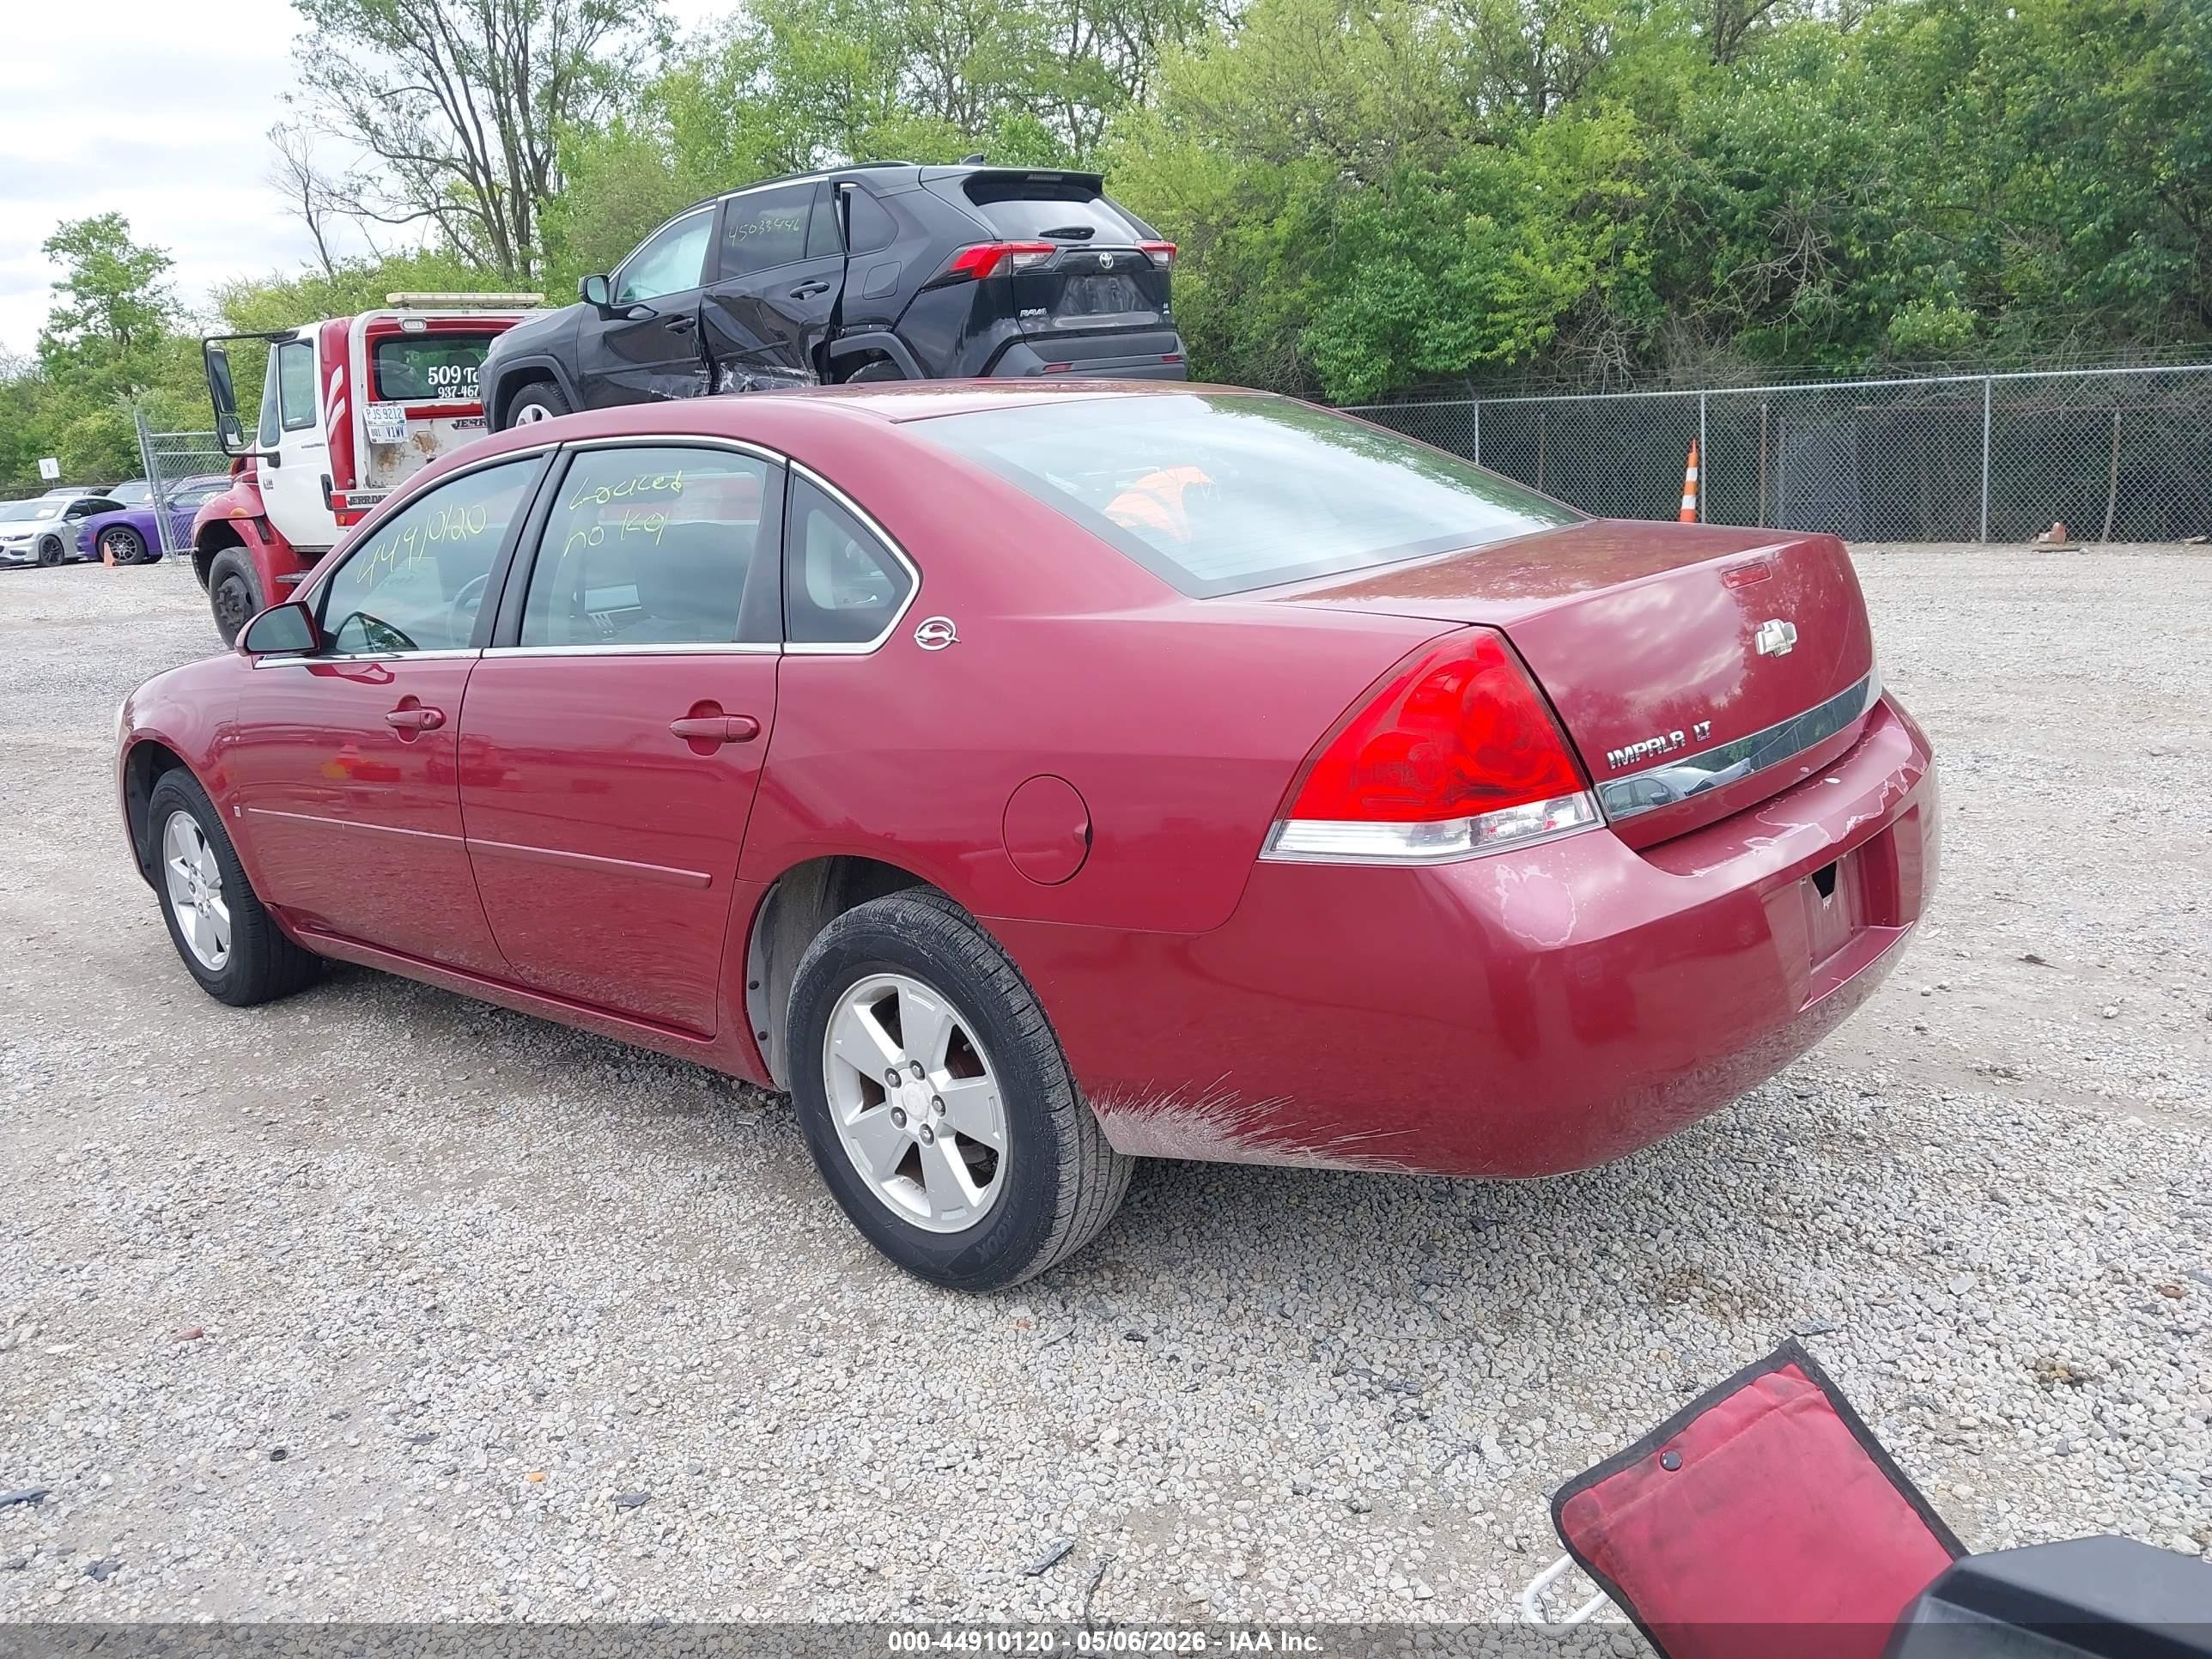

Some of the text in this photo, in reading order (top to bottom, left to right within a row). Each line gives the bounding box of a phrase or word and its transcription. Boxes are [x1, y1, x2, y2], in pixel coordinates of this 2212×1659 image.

[1019, 307, 1048, 318] RAV4
[428, 365, 461, 385] 509
[438, 385, 479, 398] 937-467
[365, 407, 403, 420] PJS 9212
[1692, 720, 1711, 742] LT
